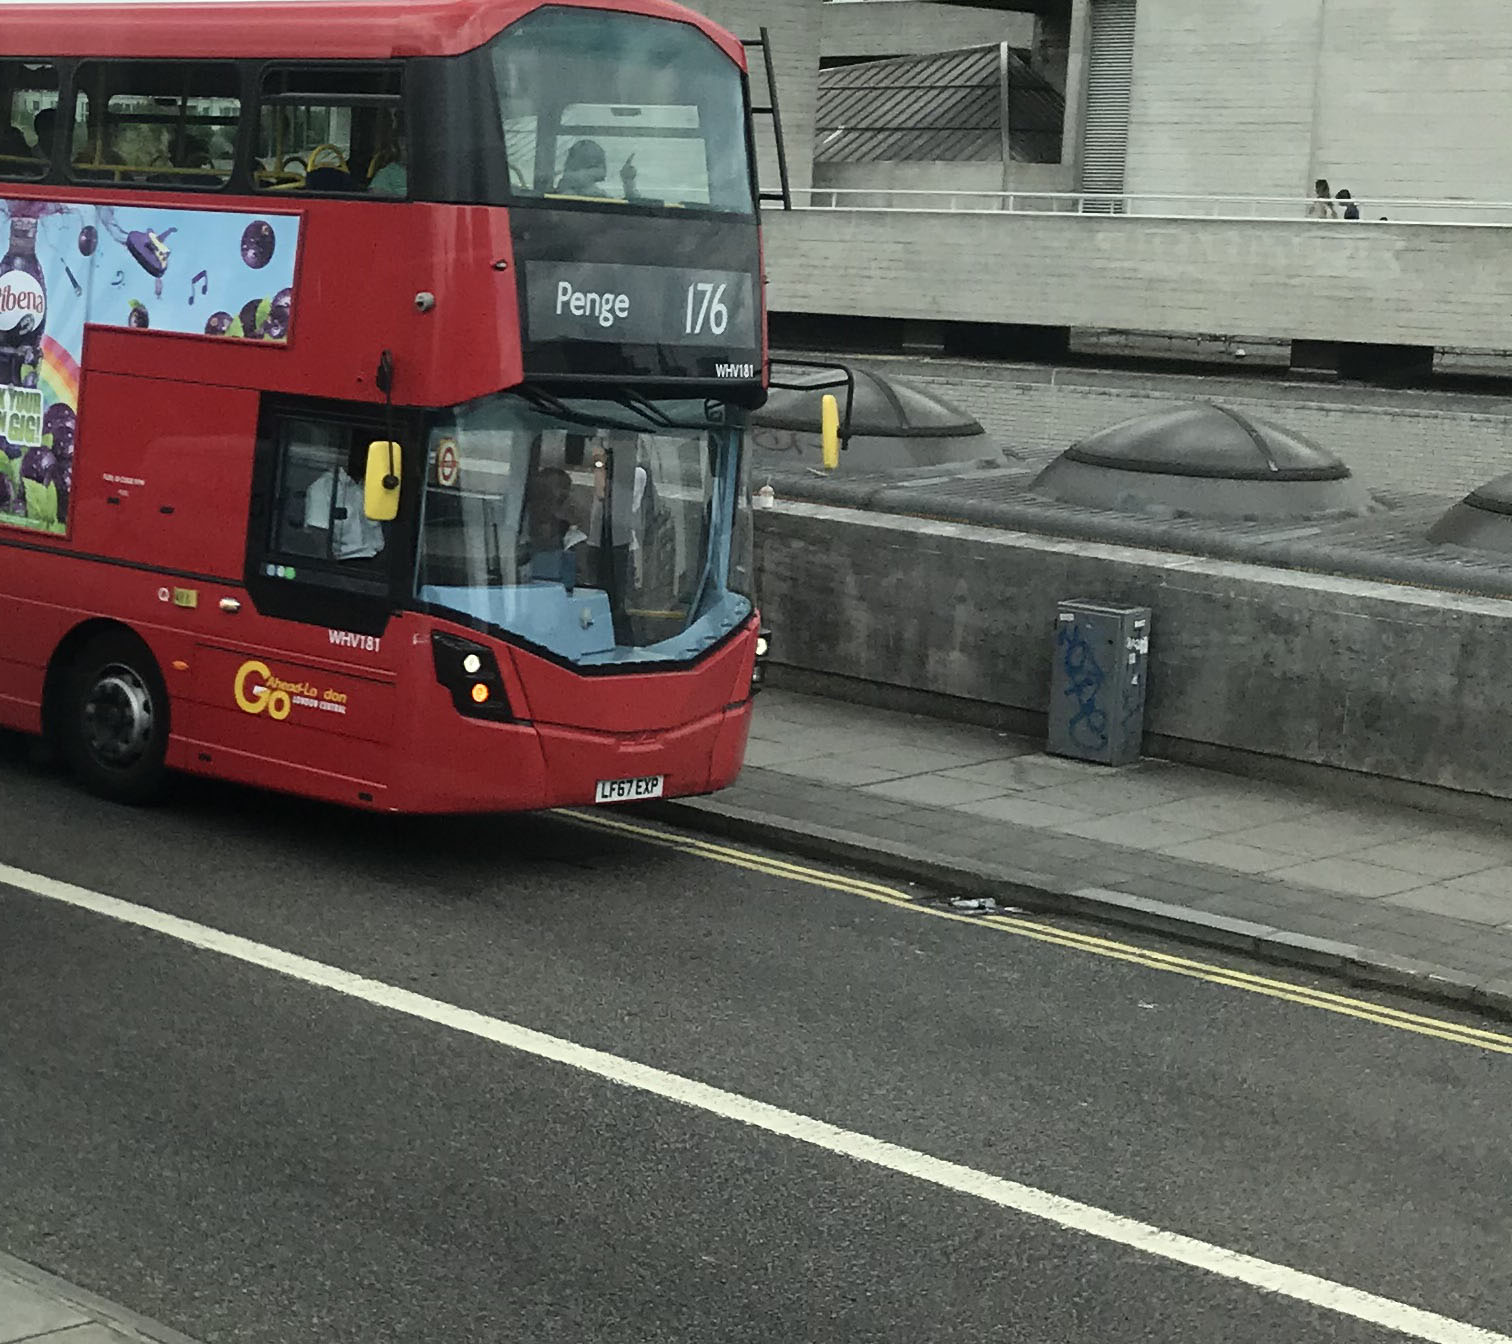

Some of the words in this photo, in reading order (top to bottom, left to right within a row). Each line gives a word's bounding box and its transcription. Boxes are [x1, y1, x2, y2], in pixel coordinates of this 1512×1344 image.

[555, 280, 630, 328] Penge
[685, 282, 729, 335] 176
[714, 363, 754, 378] WHV181
[8, 388, 42, 415] YOUR
[8, 412, 41, 444] GIG!
[328, 629, 381, 653] WHV181
[233, 659, 291, 721] Go
[600, 779, 634, 799] LF67
[634, 776, 659, 796] EXP
